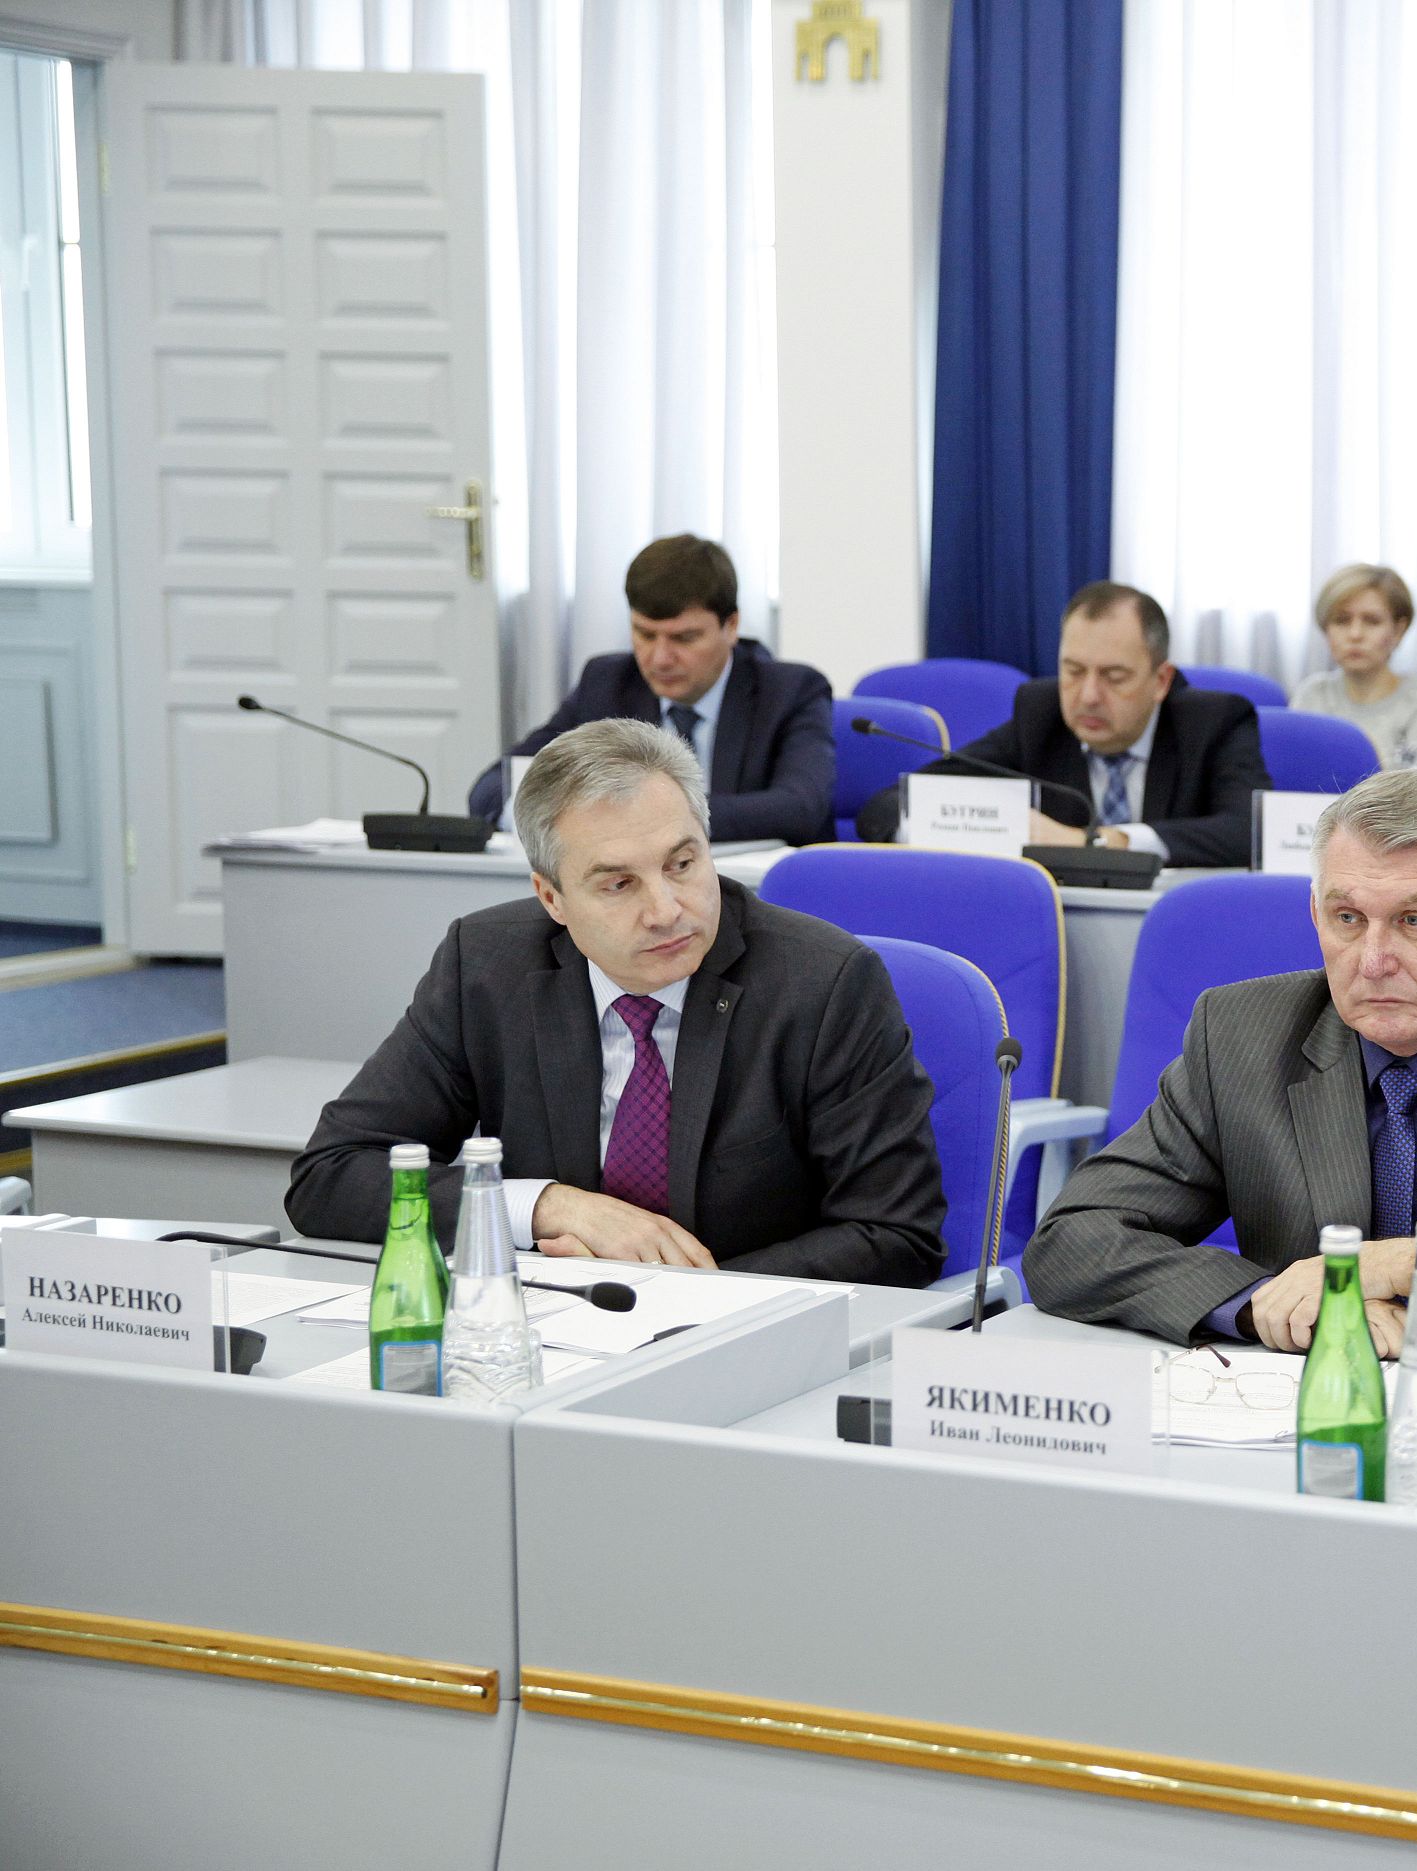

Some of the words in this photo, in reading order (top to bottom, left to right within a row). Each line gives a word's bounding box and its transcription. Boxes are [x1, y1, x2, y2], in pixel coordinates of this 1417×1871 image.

[28, 1276, 182, 1314] НАЗАРЕНКО
[22, 1308, 87, 1329] Алексей
[92, 1315, 190, 1341] Николаевич
[926, 1385, 1111, 1426] ЯКИМЕНКО
[930, 1419, 980, 1441] Иван
[985, 1425, 1106, 1455] Леонидович
